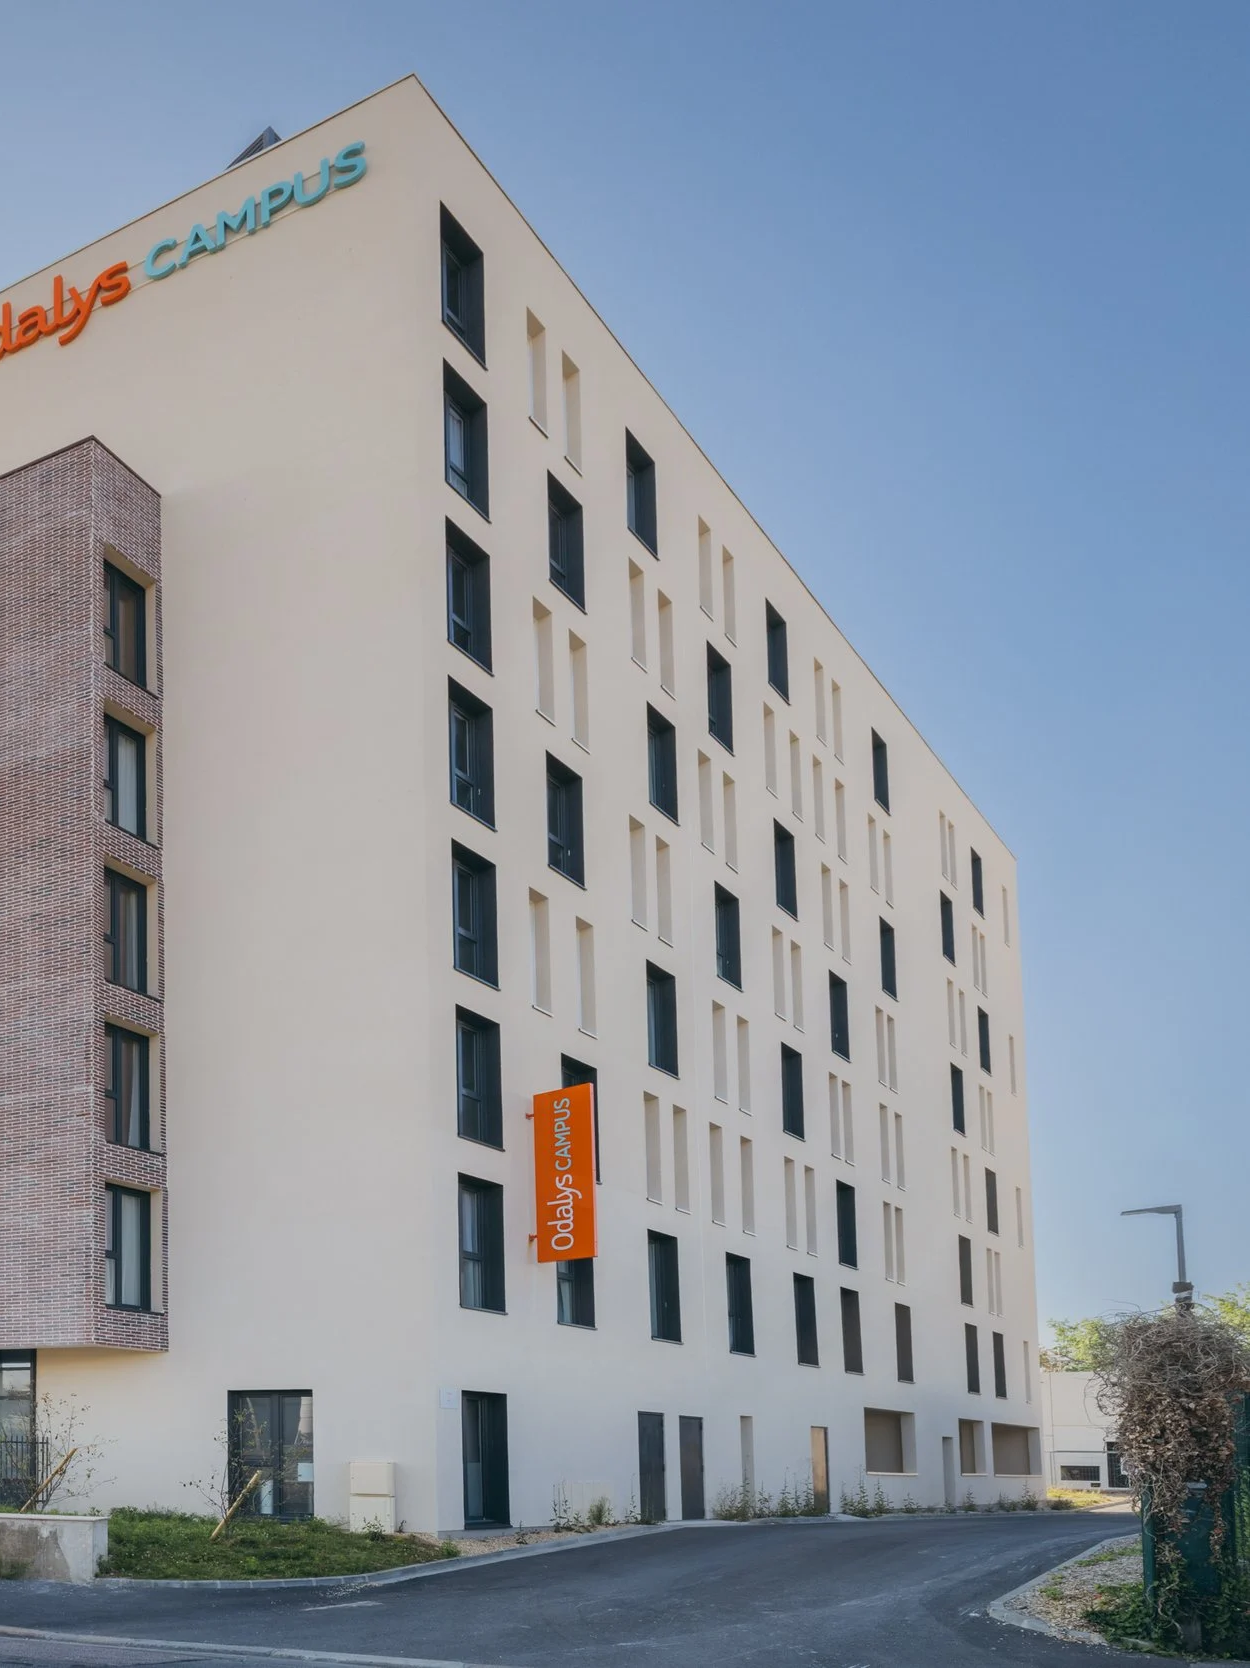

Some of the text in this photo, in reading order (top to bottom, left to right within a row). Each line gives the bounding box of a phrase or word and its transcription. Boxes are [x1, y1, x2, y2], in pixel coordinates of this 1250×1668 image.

[144, 140, 367, 281] CAMPUS
[547, 1097, 582, 1251] Odalys CAMPUS
